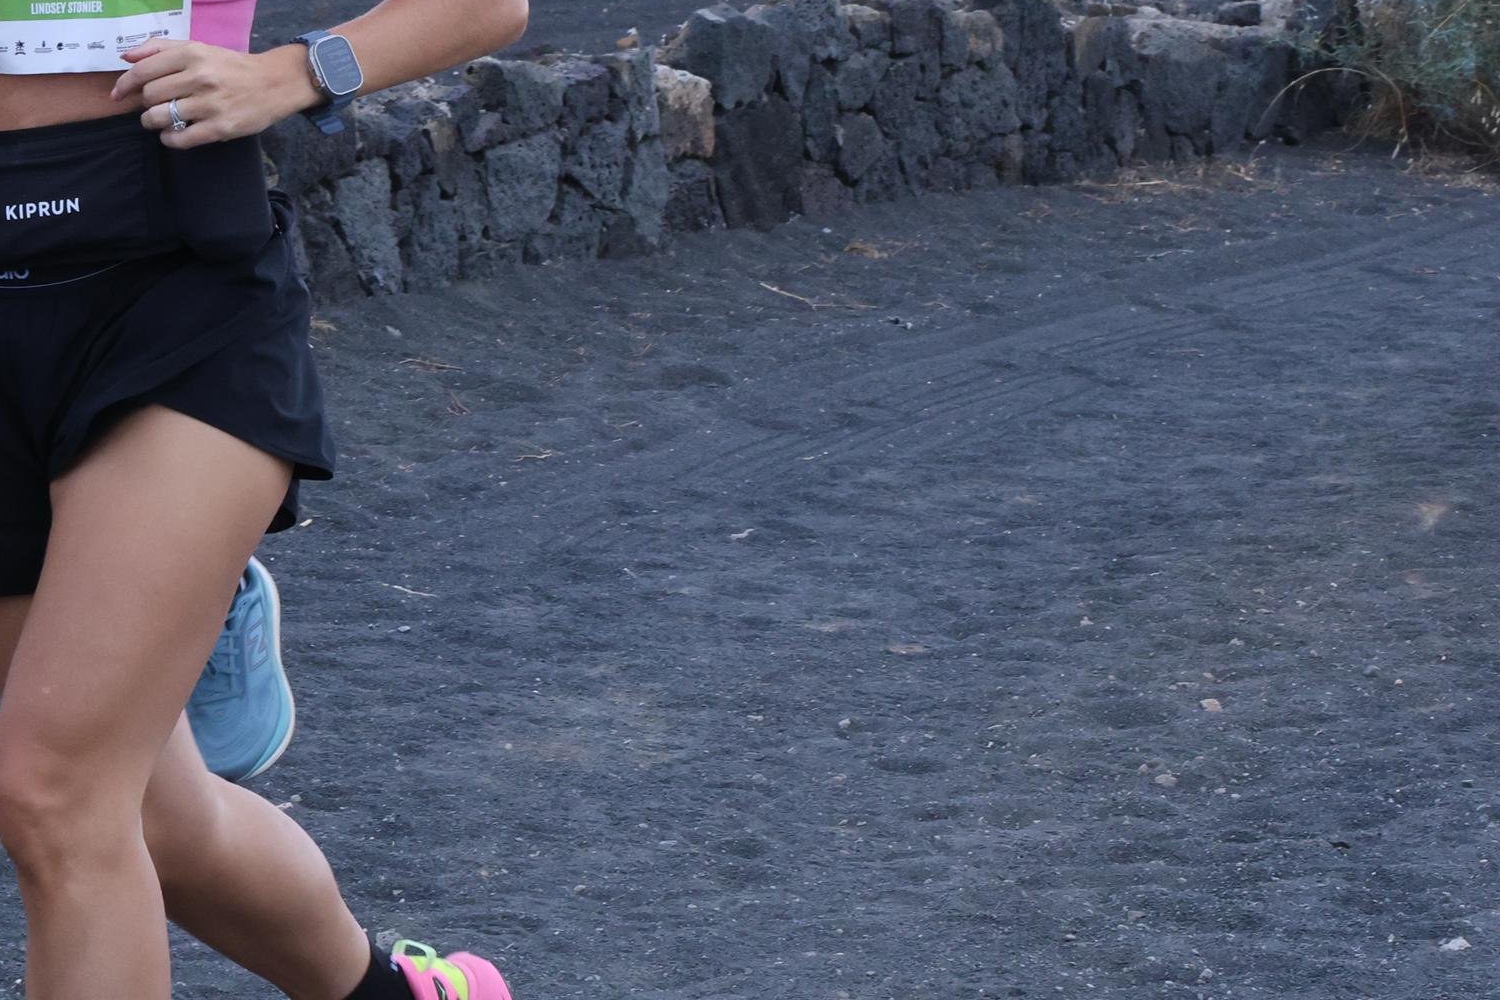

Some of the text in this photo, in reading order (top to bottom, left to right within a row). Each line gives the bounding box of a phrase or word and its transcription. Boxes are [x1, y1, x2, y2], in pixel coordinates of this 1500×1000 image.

[30, 0, 103, 15] LINDSEY STONIER
[5, 196, 81, 221] KIPRUN
